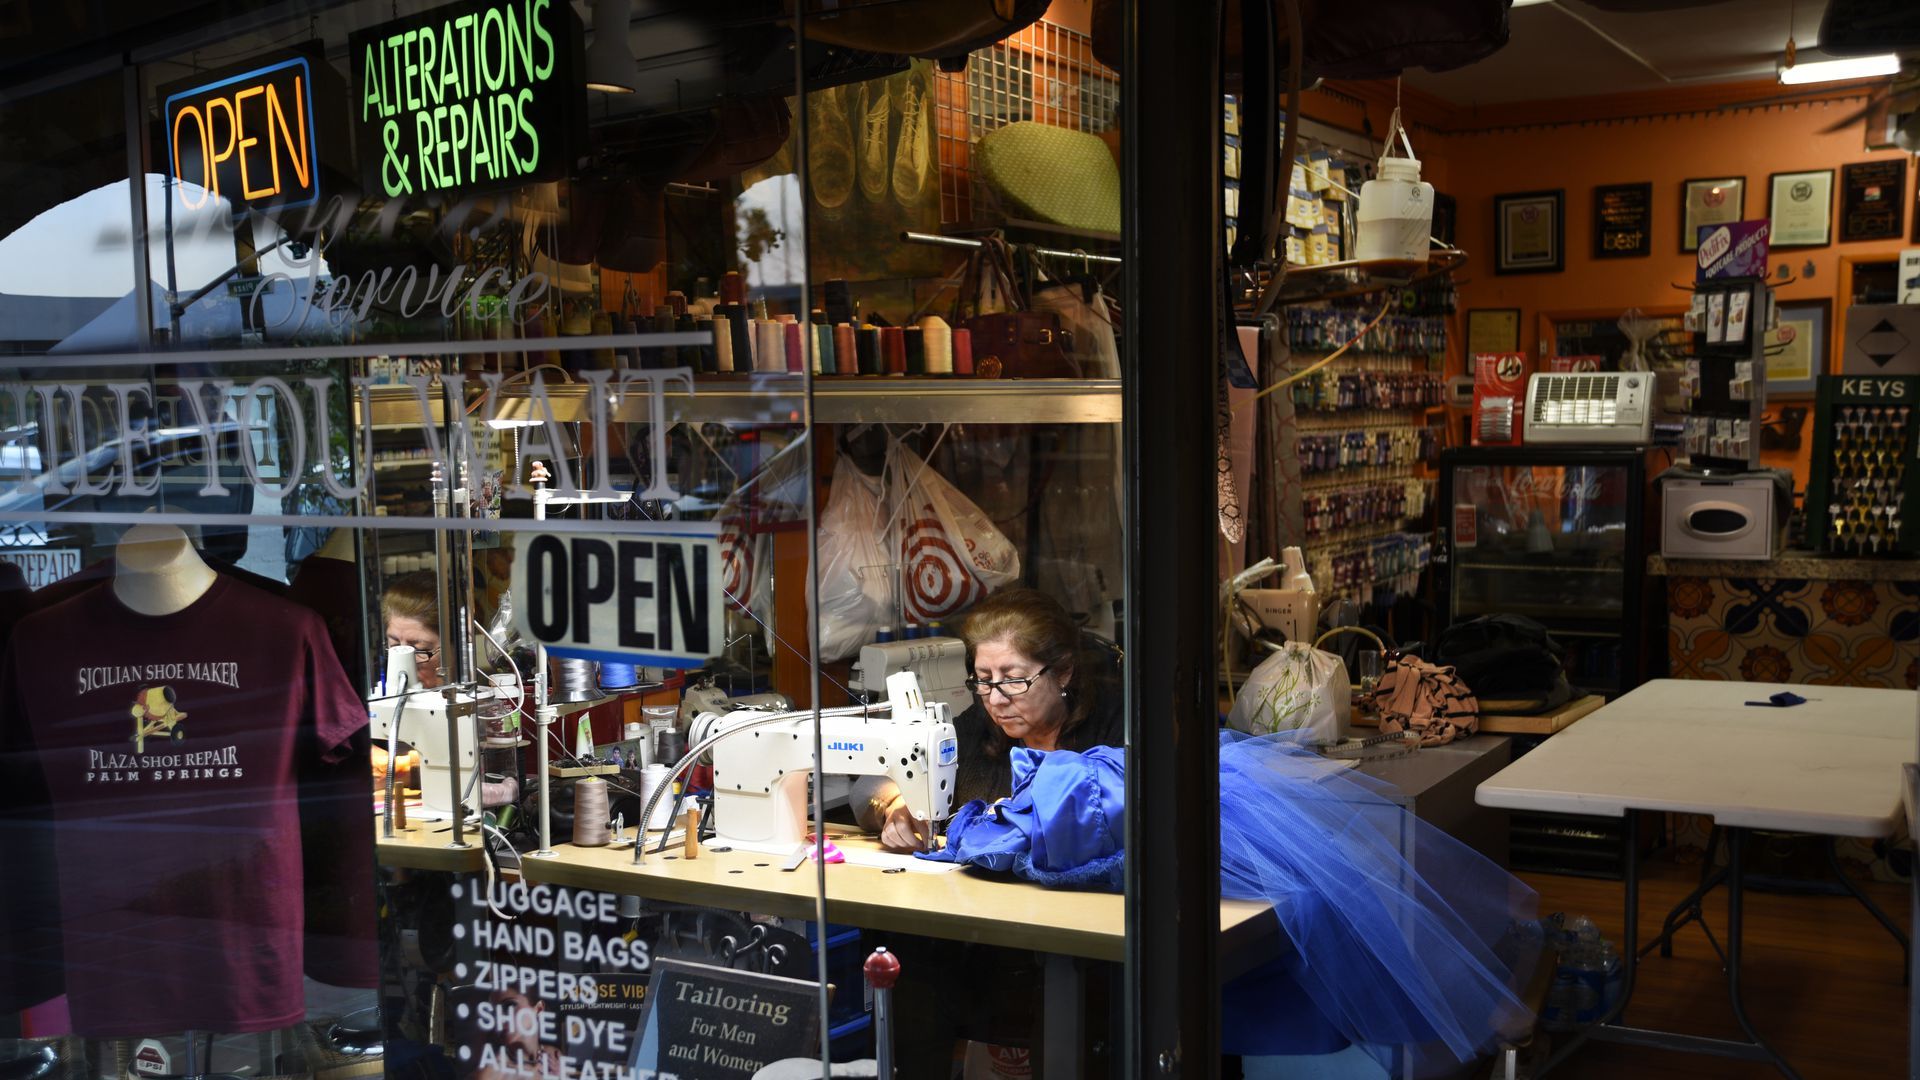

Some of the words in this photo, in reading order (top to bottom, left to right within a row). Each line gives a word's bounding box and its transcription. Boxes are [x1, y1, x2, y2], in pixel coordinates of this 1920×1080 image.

[363, 0, 555, 123] ALTERATIONS
[173, 75, 309, 210] OPEN
[382, 119, 413, 198] &
[416, 87, 540, 191] REPAIRS
[249, 194, 550, 342] Service
[1841, 378, 1905, 398] KEYS
[178, 376, 377, 500] YOU
[405, 366, 695, 502] WAIT
[527, 534, 709, 654] OPEN
[78, 664, 142, 695] SICILIAN
[146, 663, 185, 680] SHOE
[188, 662, 240, 689] MAKER
[89, 748, 139, 769] PLAZA
[142, 754, 181, 769] SHOE
[186, 745, 239, 766] REPAIR
[828, 742, 864, 751] JUKI
[941, 745, 955, 755] JUKI
[87, 771, 140, 782] PALM
[154, 767, 244, 781] SPRINGS
[470, 877, 618, 923] LUGGAGE
[473, 918, 555, 958] HAND
[563, 930, 651, 971] BAGS
[474, 959, 598, 1005] ZIPPERS
[621, 983, 649, 999] VIB
[560, 1003, 585, 1011] STYLISH
[676, 981, 791, 1026] Tailoring
[477, 1000, 558, 1042] SHOE
[566, 1014, 627, 1053] DYE
[689, 1017, 718, 1037] For
[719, 1021, 757, 1045] Men
[479, 1042, 534, 1077] ALL
[668, 1044, 701, 1061] and
[703, 1046, 764, 1073] Women
